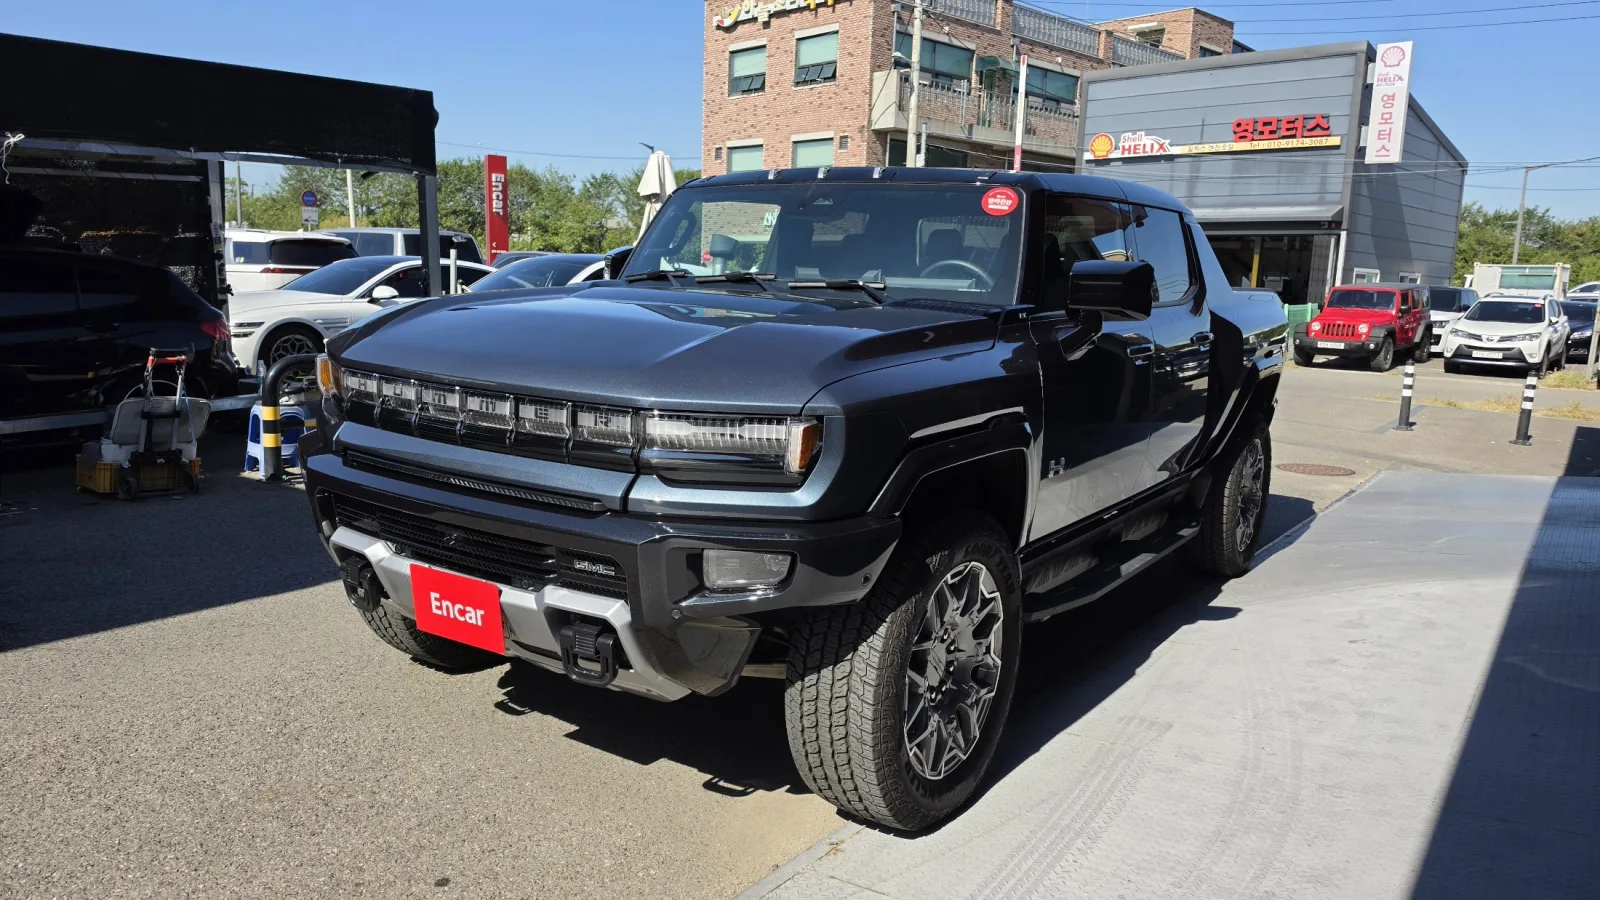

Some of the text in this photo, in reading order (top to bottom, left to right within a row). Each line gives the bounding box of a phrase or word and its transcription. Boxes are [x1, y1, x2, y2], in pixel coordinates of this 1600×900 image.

[1376, 75, 1404, 83] HELIX
[1231, 113, 1331, 143] 영모터스
[1375, 93, 1396, 157] 영모터스
[1120, 138, 1170, 155] HELIX
[1121, 133, 1143, 144] Shell
[1267, 138, 1329, 148] 010-9174-3087
[491, 173, 505, 216] Encar
[573, 559, 615, 576] GMC
[430, 592, 486, 627] Encar
